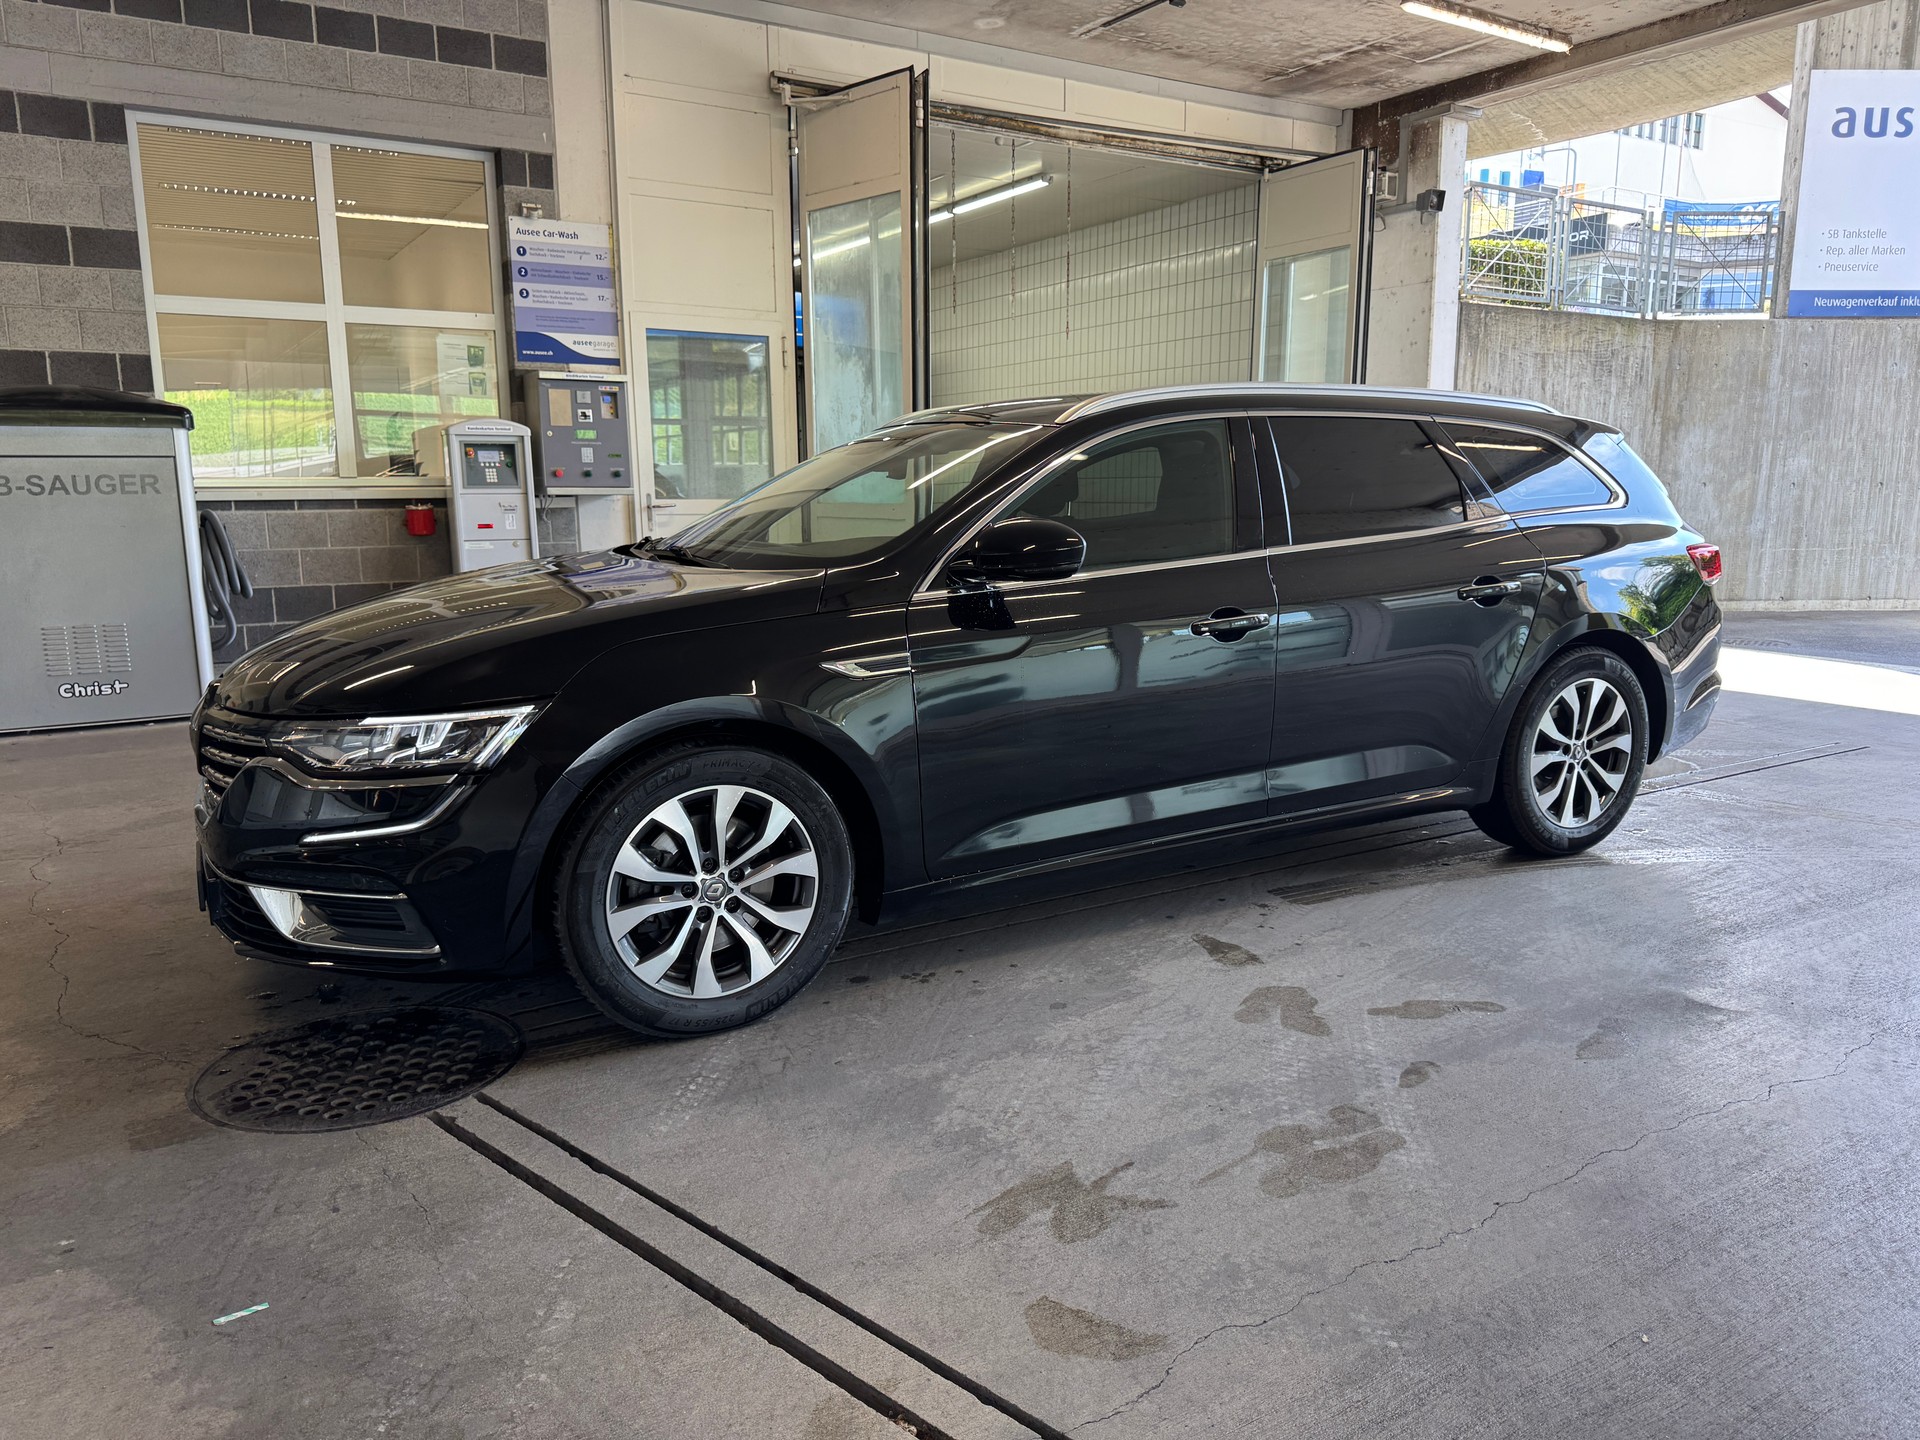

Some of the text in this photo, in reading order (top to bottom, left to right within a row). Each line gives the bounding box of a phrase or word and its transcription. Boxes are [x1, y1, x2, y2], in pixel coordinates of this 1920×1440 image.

[1831, 106, 1915, 139] aus
[515, 227, 579, 240] Ausee Car-Wash
[1827, 228, 1887, 239] SB Tankstelle
[1826, 245, 1906, 257] Rep. aller Marken
[1824, 262, 1879, 272] Pneuservice
[1814, 295, 1899, 309] Neuwagenverkauf
[57, 679, 129, 699] Christ
